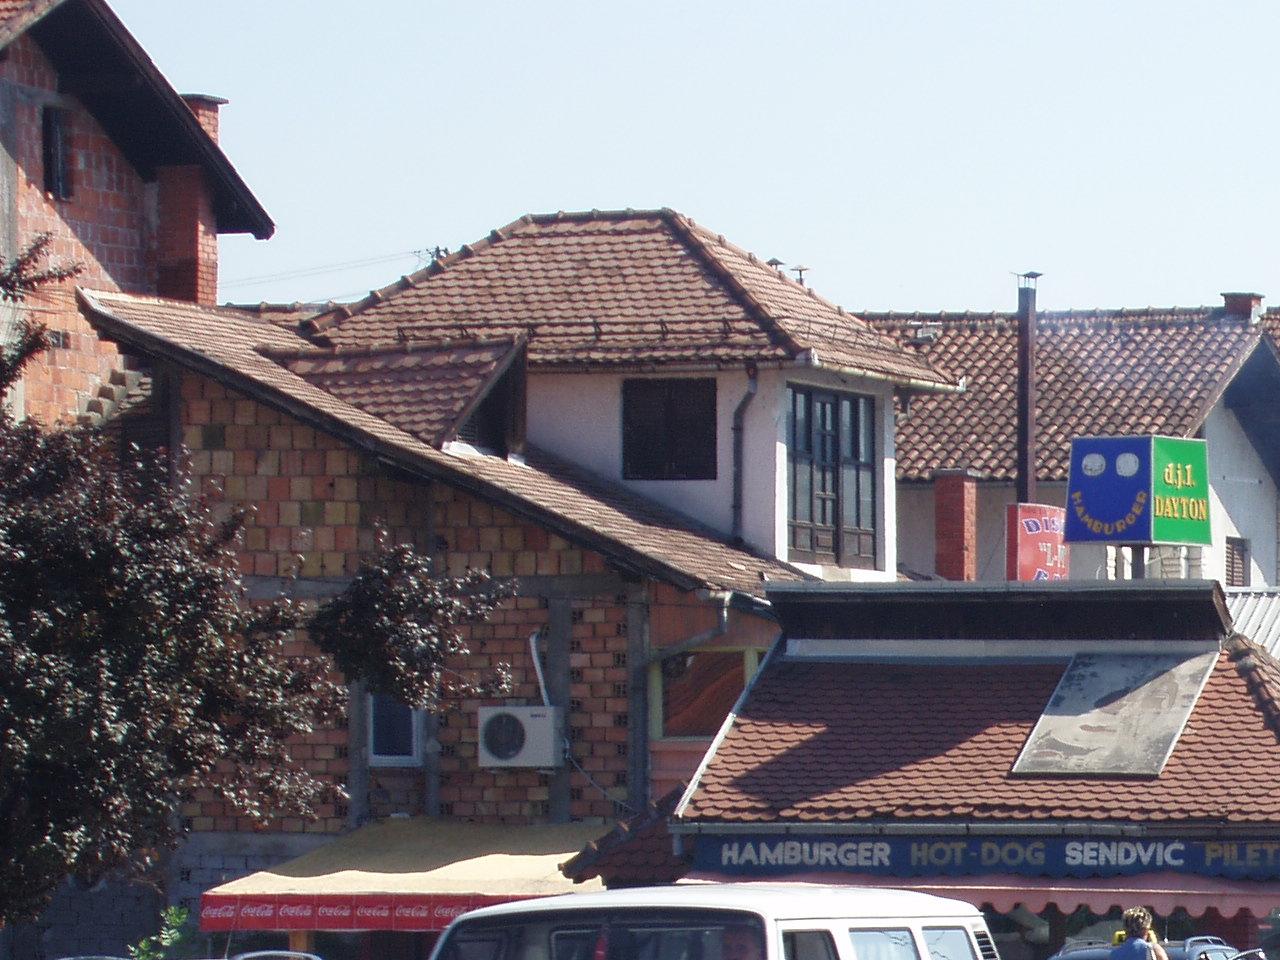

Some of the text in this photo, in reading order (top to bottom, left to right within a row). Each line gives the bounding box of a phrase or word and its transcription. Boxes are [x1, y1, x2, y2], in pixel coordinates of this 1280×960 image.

[1071, 490, 1148, 536] HAMBURGER
[1154, 496, 1207, 521] DAYTON
[1022, 516, 1065, 535] DIS
[721, 842, 891, 867] HAMBURGER
[1065, 839, 1185, 867] SENDVIĆ
